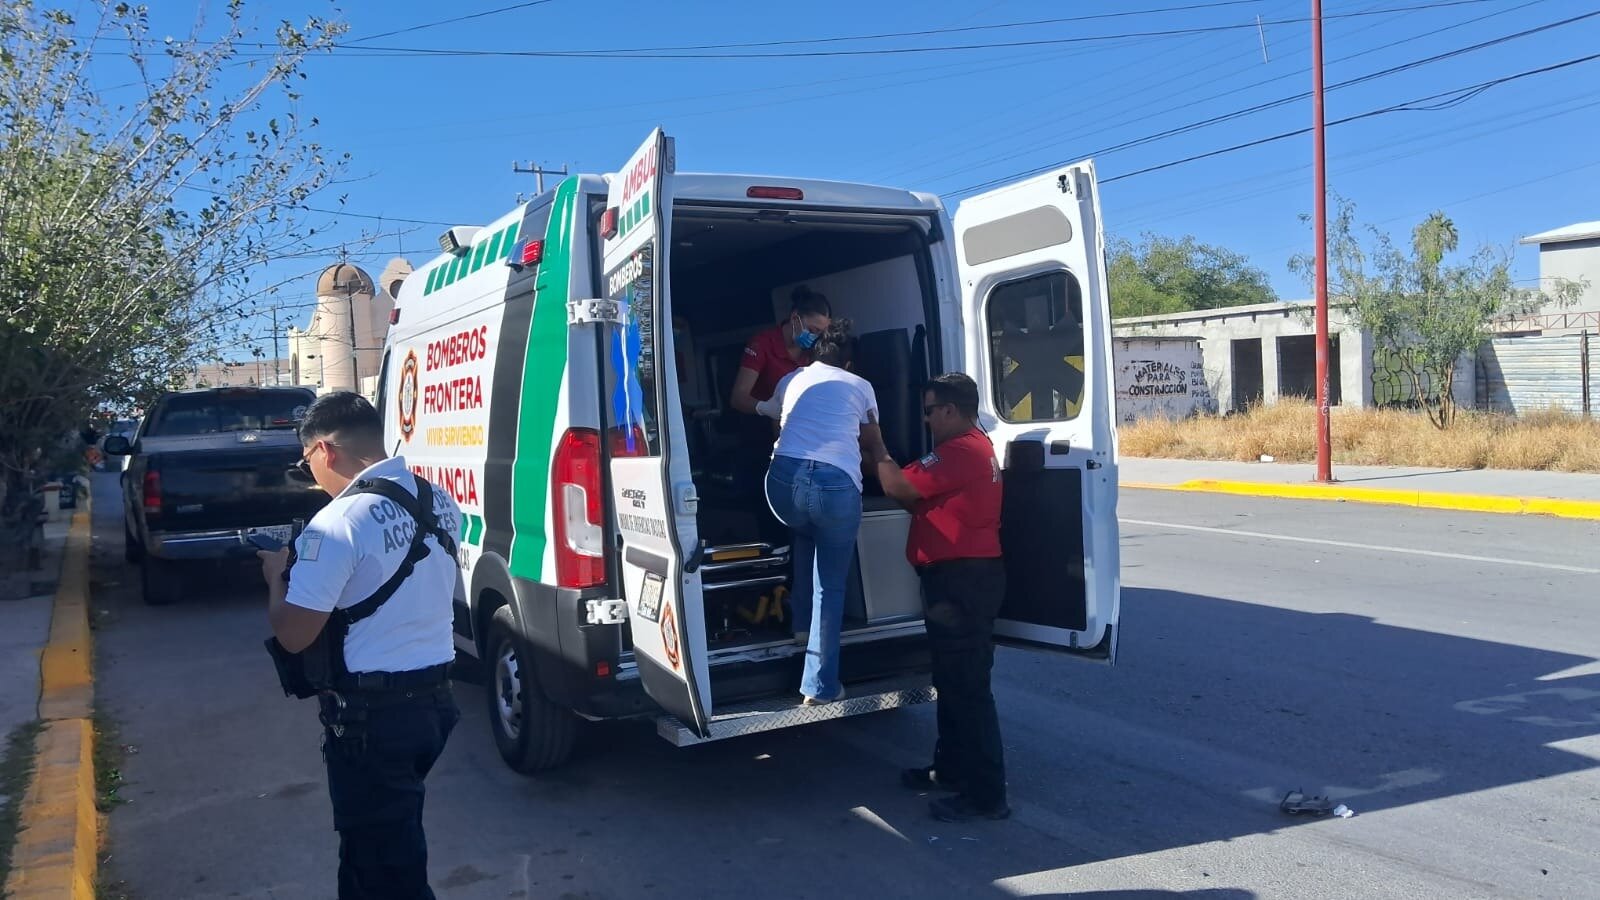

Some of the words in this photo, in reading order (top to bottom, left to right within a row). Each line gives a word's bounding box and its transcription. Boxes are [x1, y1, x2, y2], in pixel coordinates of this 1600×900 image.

[608, 252, 643, 297] BOMBEROS
[426, 325, 487, 372] BOMBEROS
[424, 375, 483, 415] FRONTERA
[1147, 372, 1171, 383] PARA
[426, 426, 443, 447] VIVIR
